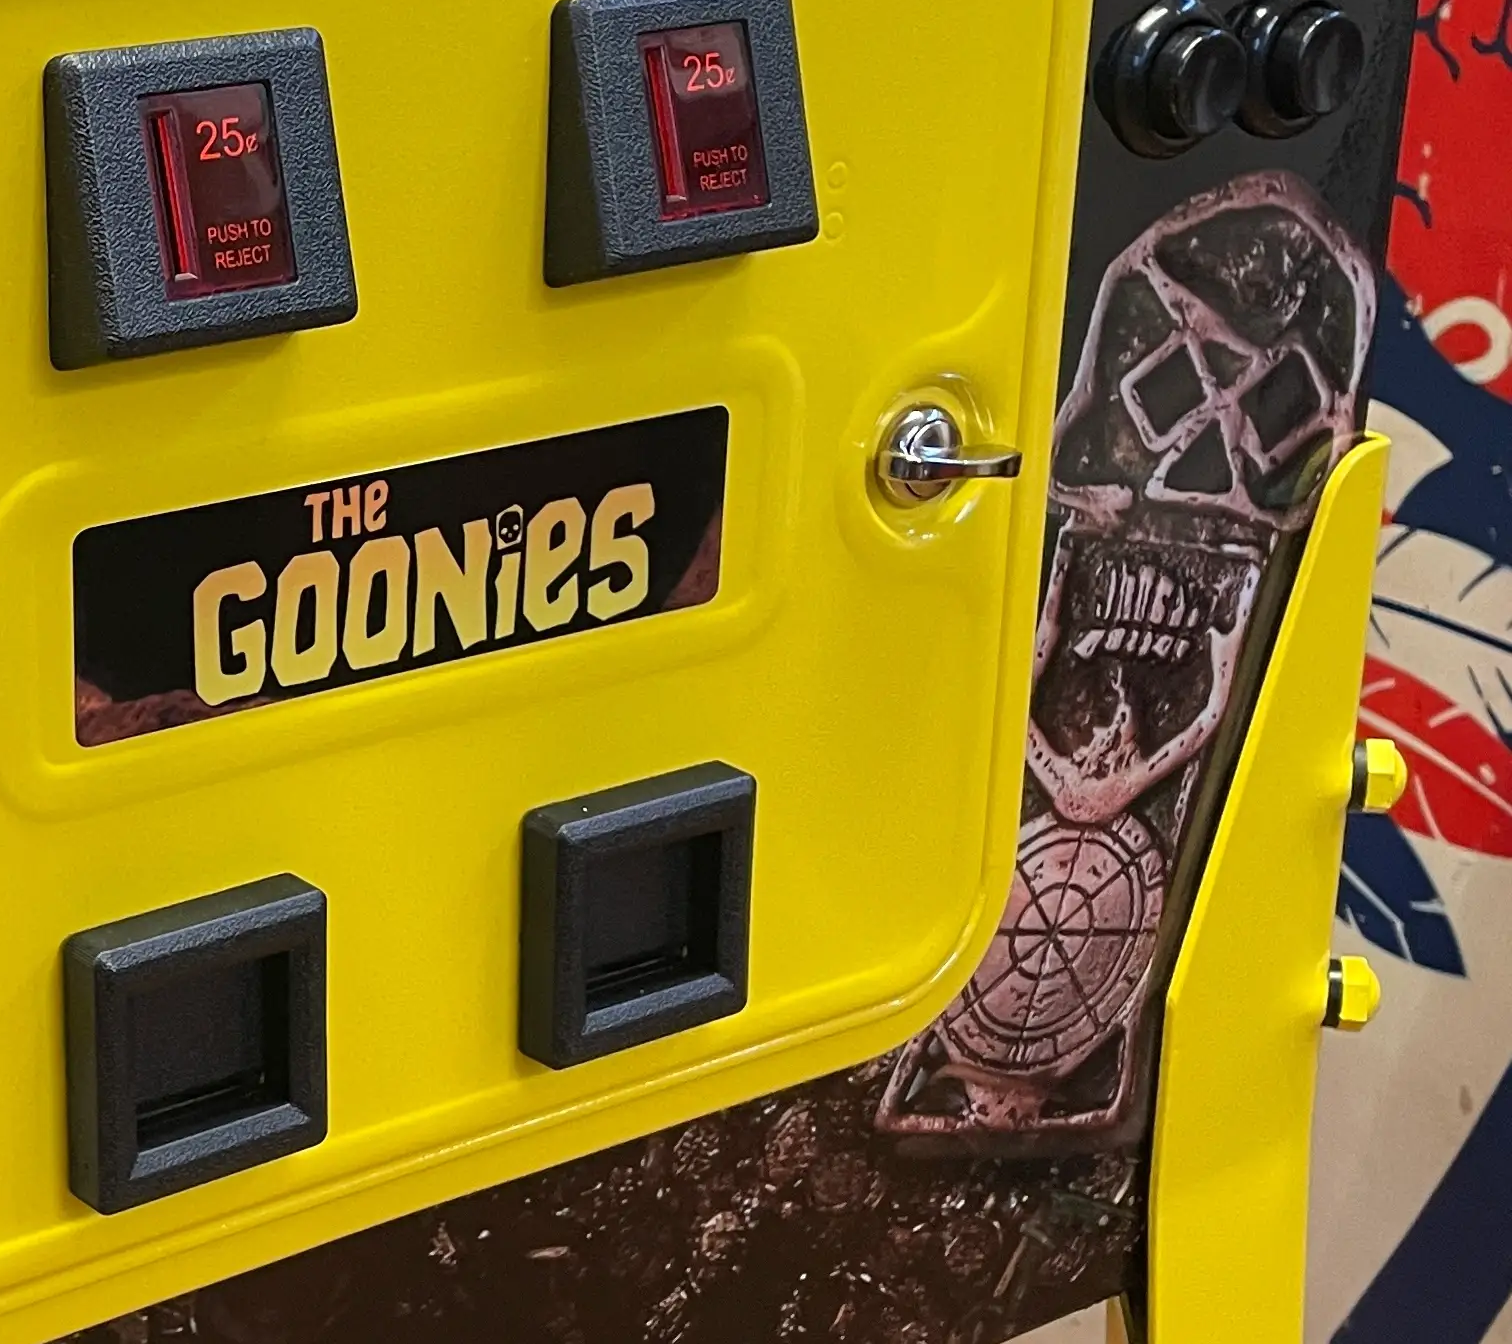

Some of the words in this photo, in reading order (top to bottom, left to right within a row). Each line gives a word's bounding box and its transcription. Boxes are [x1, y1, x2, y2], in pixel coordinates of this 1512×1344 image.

[196, 117, 259, 161] 25¢
[693, 148, 727, 168] PUSH
[728, 145, 748, 163] TO
[700, 168, 747, 190] REJECT
[208, 220, 249, 244] PUSH
[250, 218, 272, 238] TO
[215, 244, 271, 271] REJECT
